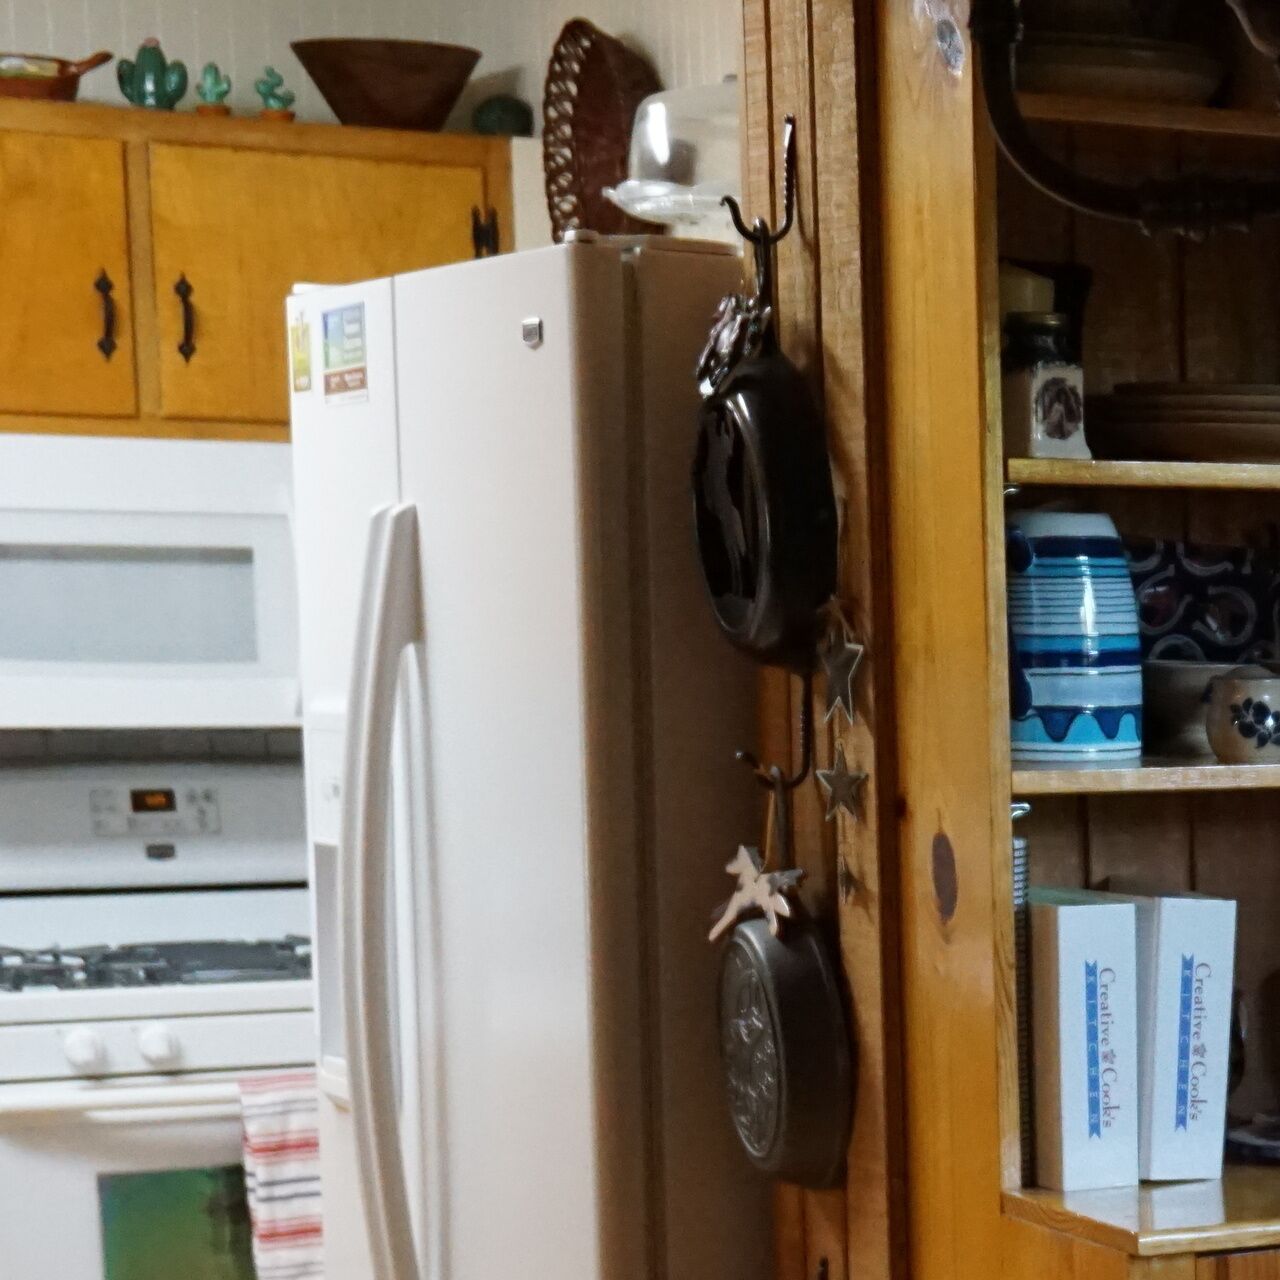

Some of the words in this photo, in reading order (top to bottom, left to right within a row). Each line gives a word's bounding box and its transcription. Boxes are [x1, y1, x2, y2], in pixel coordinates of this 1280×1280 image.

[1100, 968, 1116, 1045] Creative
[1192, 962, 1211, 1040] Creative
[1087, 976, 1099, 1123] KITCHEN
[1178, 970, 1191, 1114] KITCHEN
[1102, 1068, 1120, 1128] Cook's
[1189, 1061, 1208, 1121] Cook's
